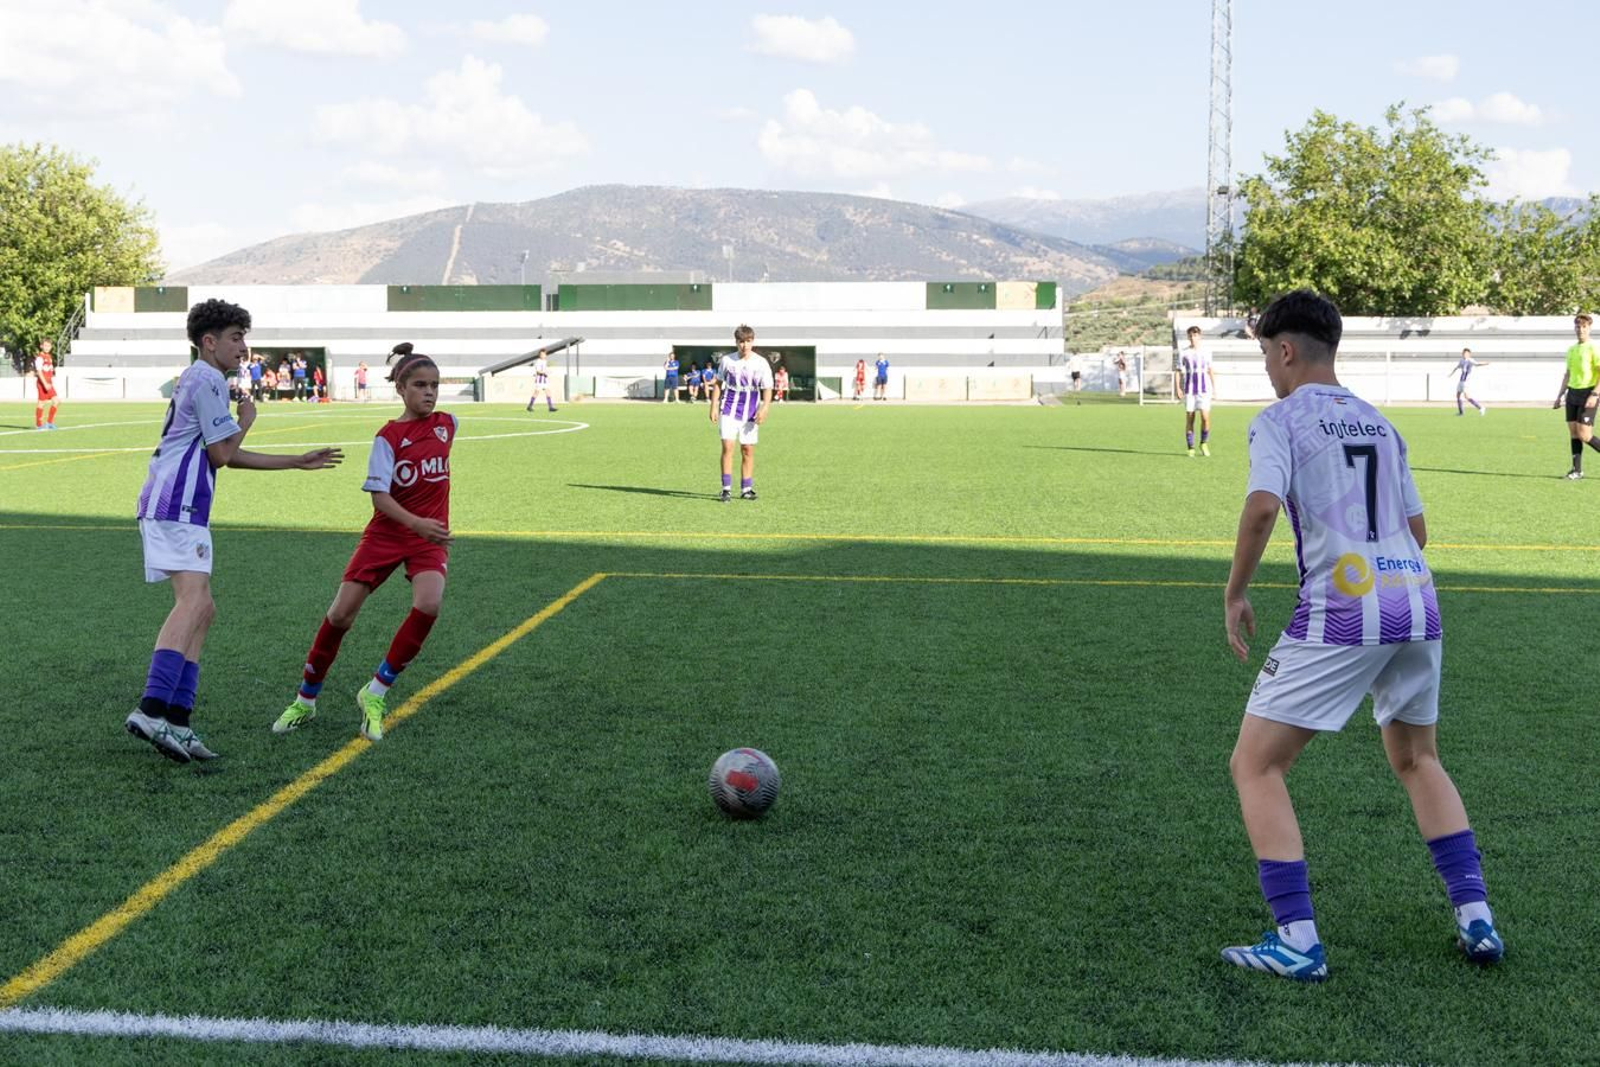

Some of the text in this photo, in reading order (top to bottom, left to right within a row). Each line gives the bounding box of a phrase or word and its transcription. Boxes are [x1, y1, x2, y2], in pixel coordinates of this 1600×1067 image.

[1319, 419, 1387, 439] intelec
[1343, 443, 1378, 542] 7
[1376, 556, 1422, 573] Energy
